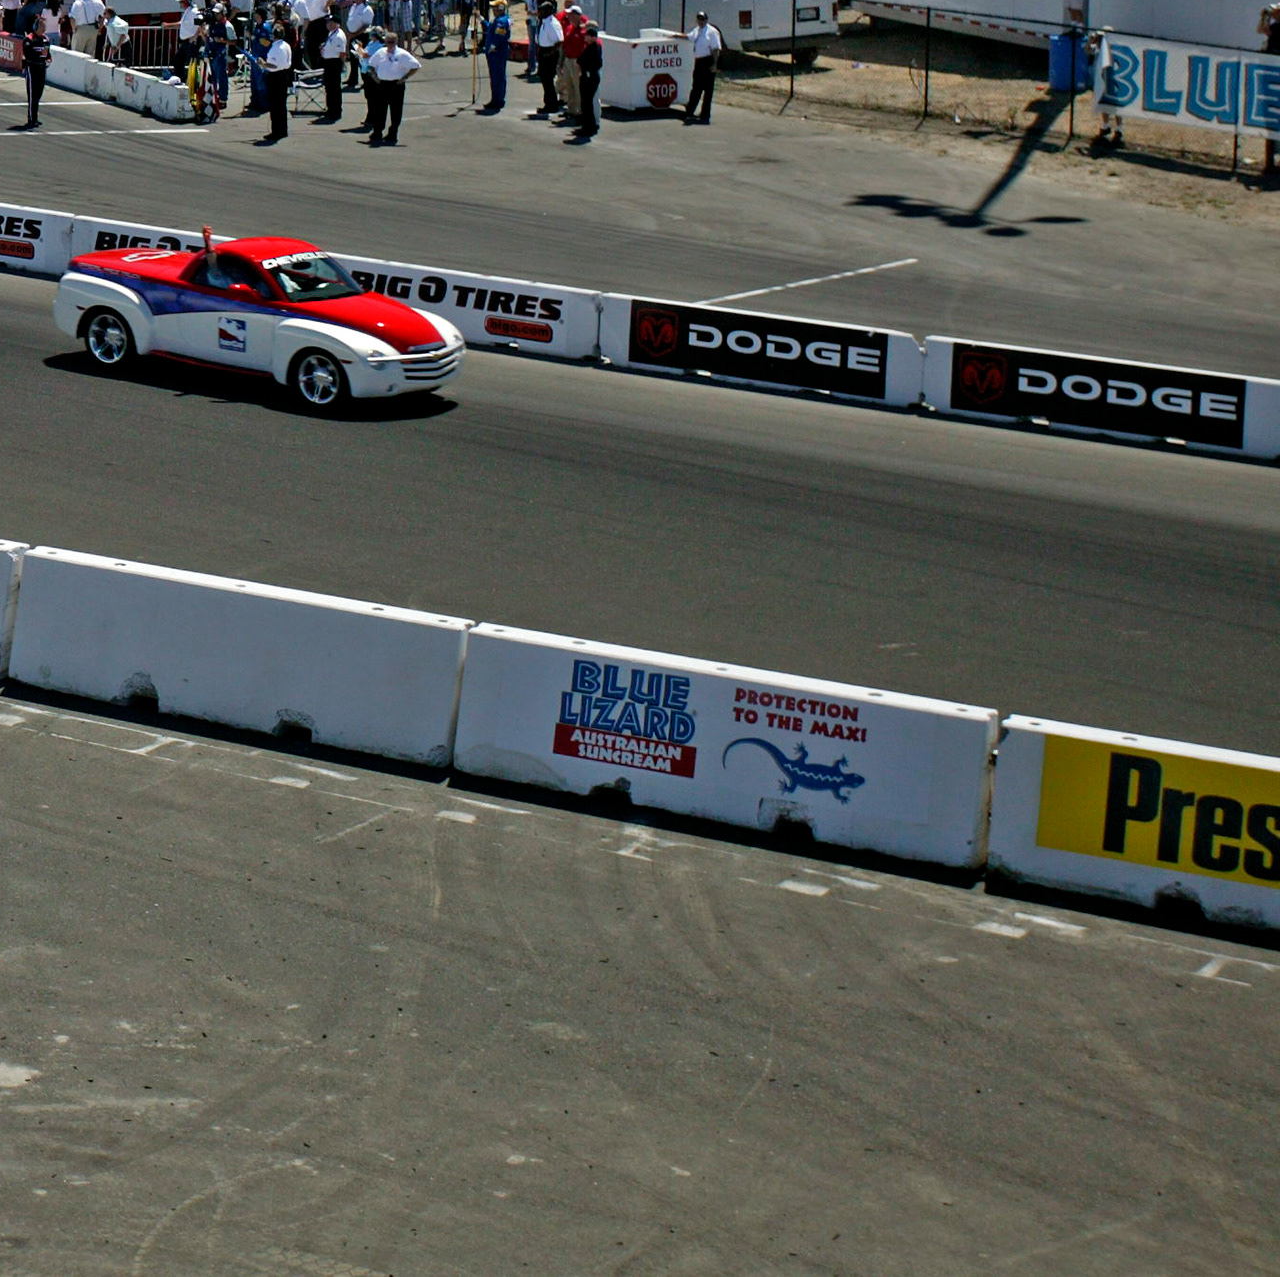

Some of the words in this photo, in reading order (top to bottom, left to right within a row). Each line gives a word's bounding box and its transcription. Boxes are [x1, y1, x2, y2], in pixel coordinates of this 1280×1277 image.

[643, 57, 682, 69] CLOSED
[647, 44, 679, 56] TRACK
[648, 84, 677, 99] STOP
[1098, 43, 1280, 132] BLUE
[261, 251, 329, 270] CHEVROLET
[351, 269, 413, 300] BIG
[418, 275, 447, 304] O
[452, 284, 564, 322] TIRES
[687, 322, 882, 373] DODGE
[1017, 367, 1239, 421] DODGE
[571, 659, 690, 712] BLUE
[559, 691, 696, 745] LIZARD
[734, 687, 860, 722] PROTECTION
[733, 706, 760, 725] TO
[765, 712, 803, 733] THE
[811, 718, 868, 743] MAX!
[569, 727, 682, 761] AUSTRALIAN
[577, 744, 672, 773] SUNCREAM
[1102, 751, 1280, 881] Pres
